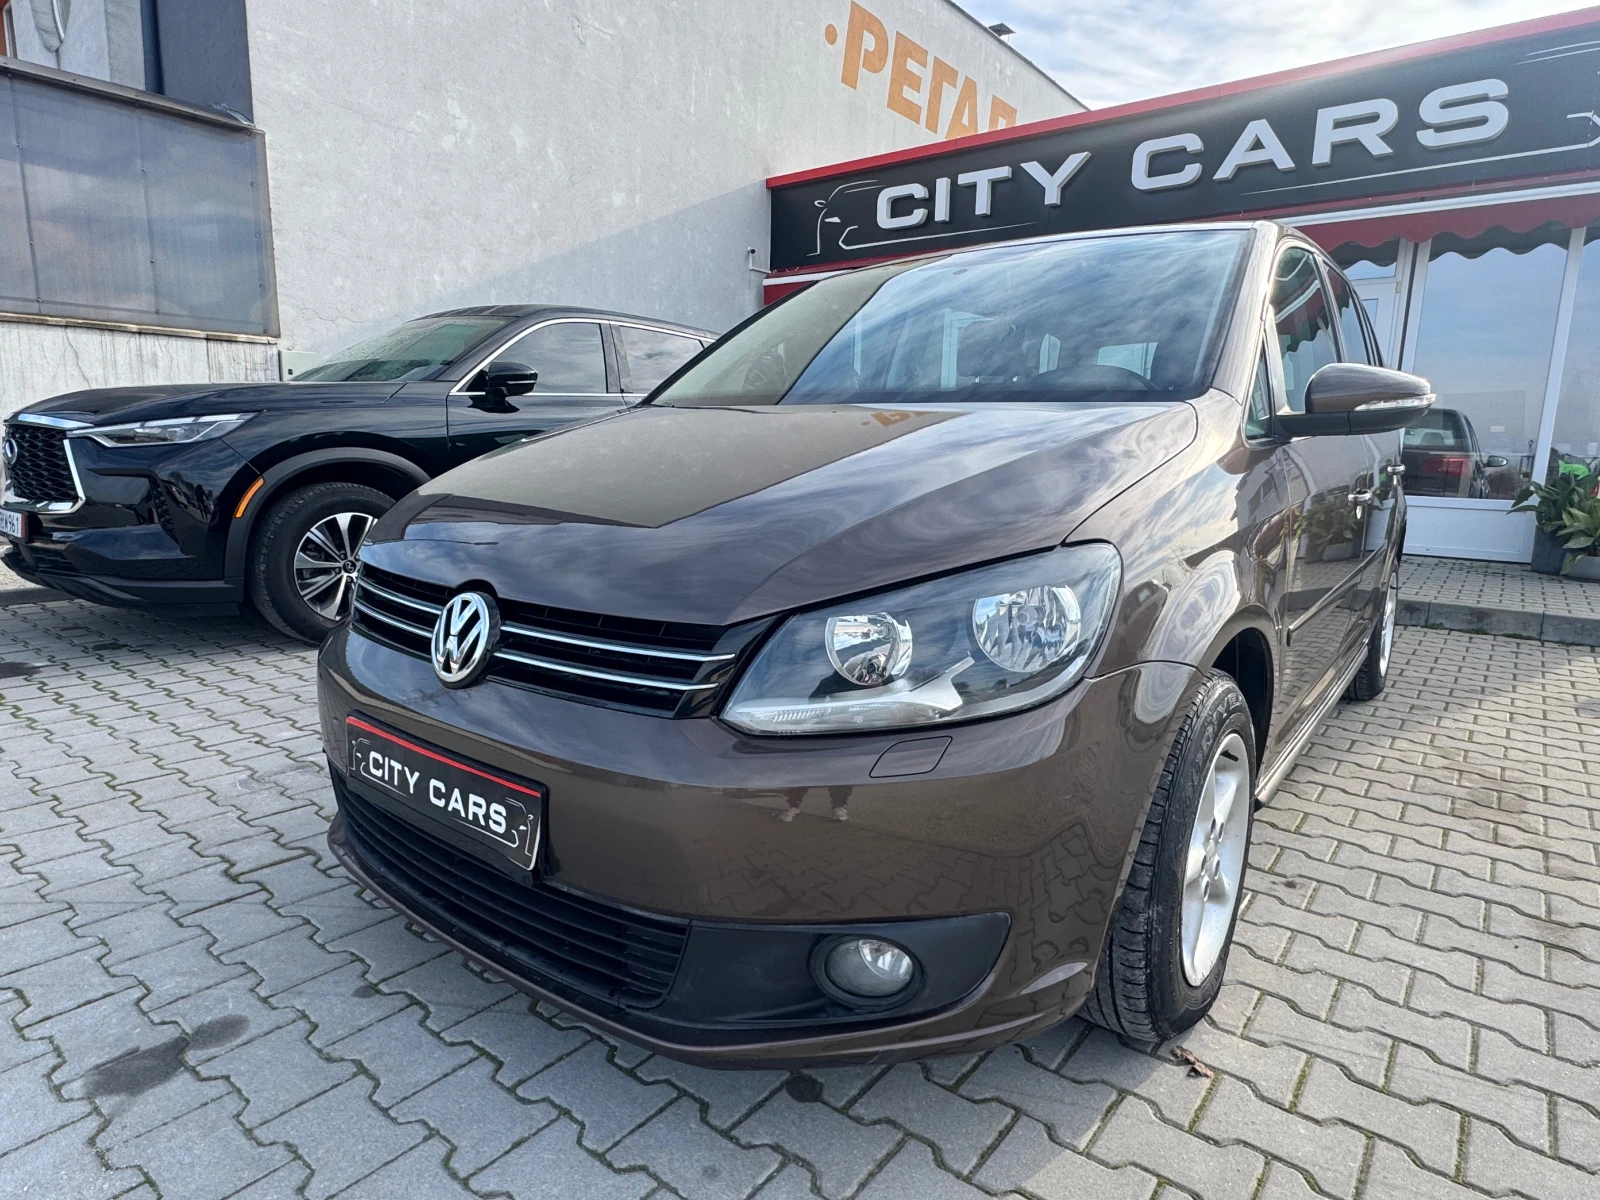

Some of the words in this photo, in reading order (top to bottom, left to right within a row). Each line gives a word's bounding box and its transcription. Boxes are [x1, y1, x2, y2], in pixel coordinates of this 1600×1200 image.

[876, 150, 1092, 230] CITY
[1131, 78, 1509, 190] CARS
[369, 751, 420, 794] CITY
[429, 778, 507, 834] CARS
